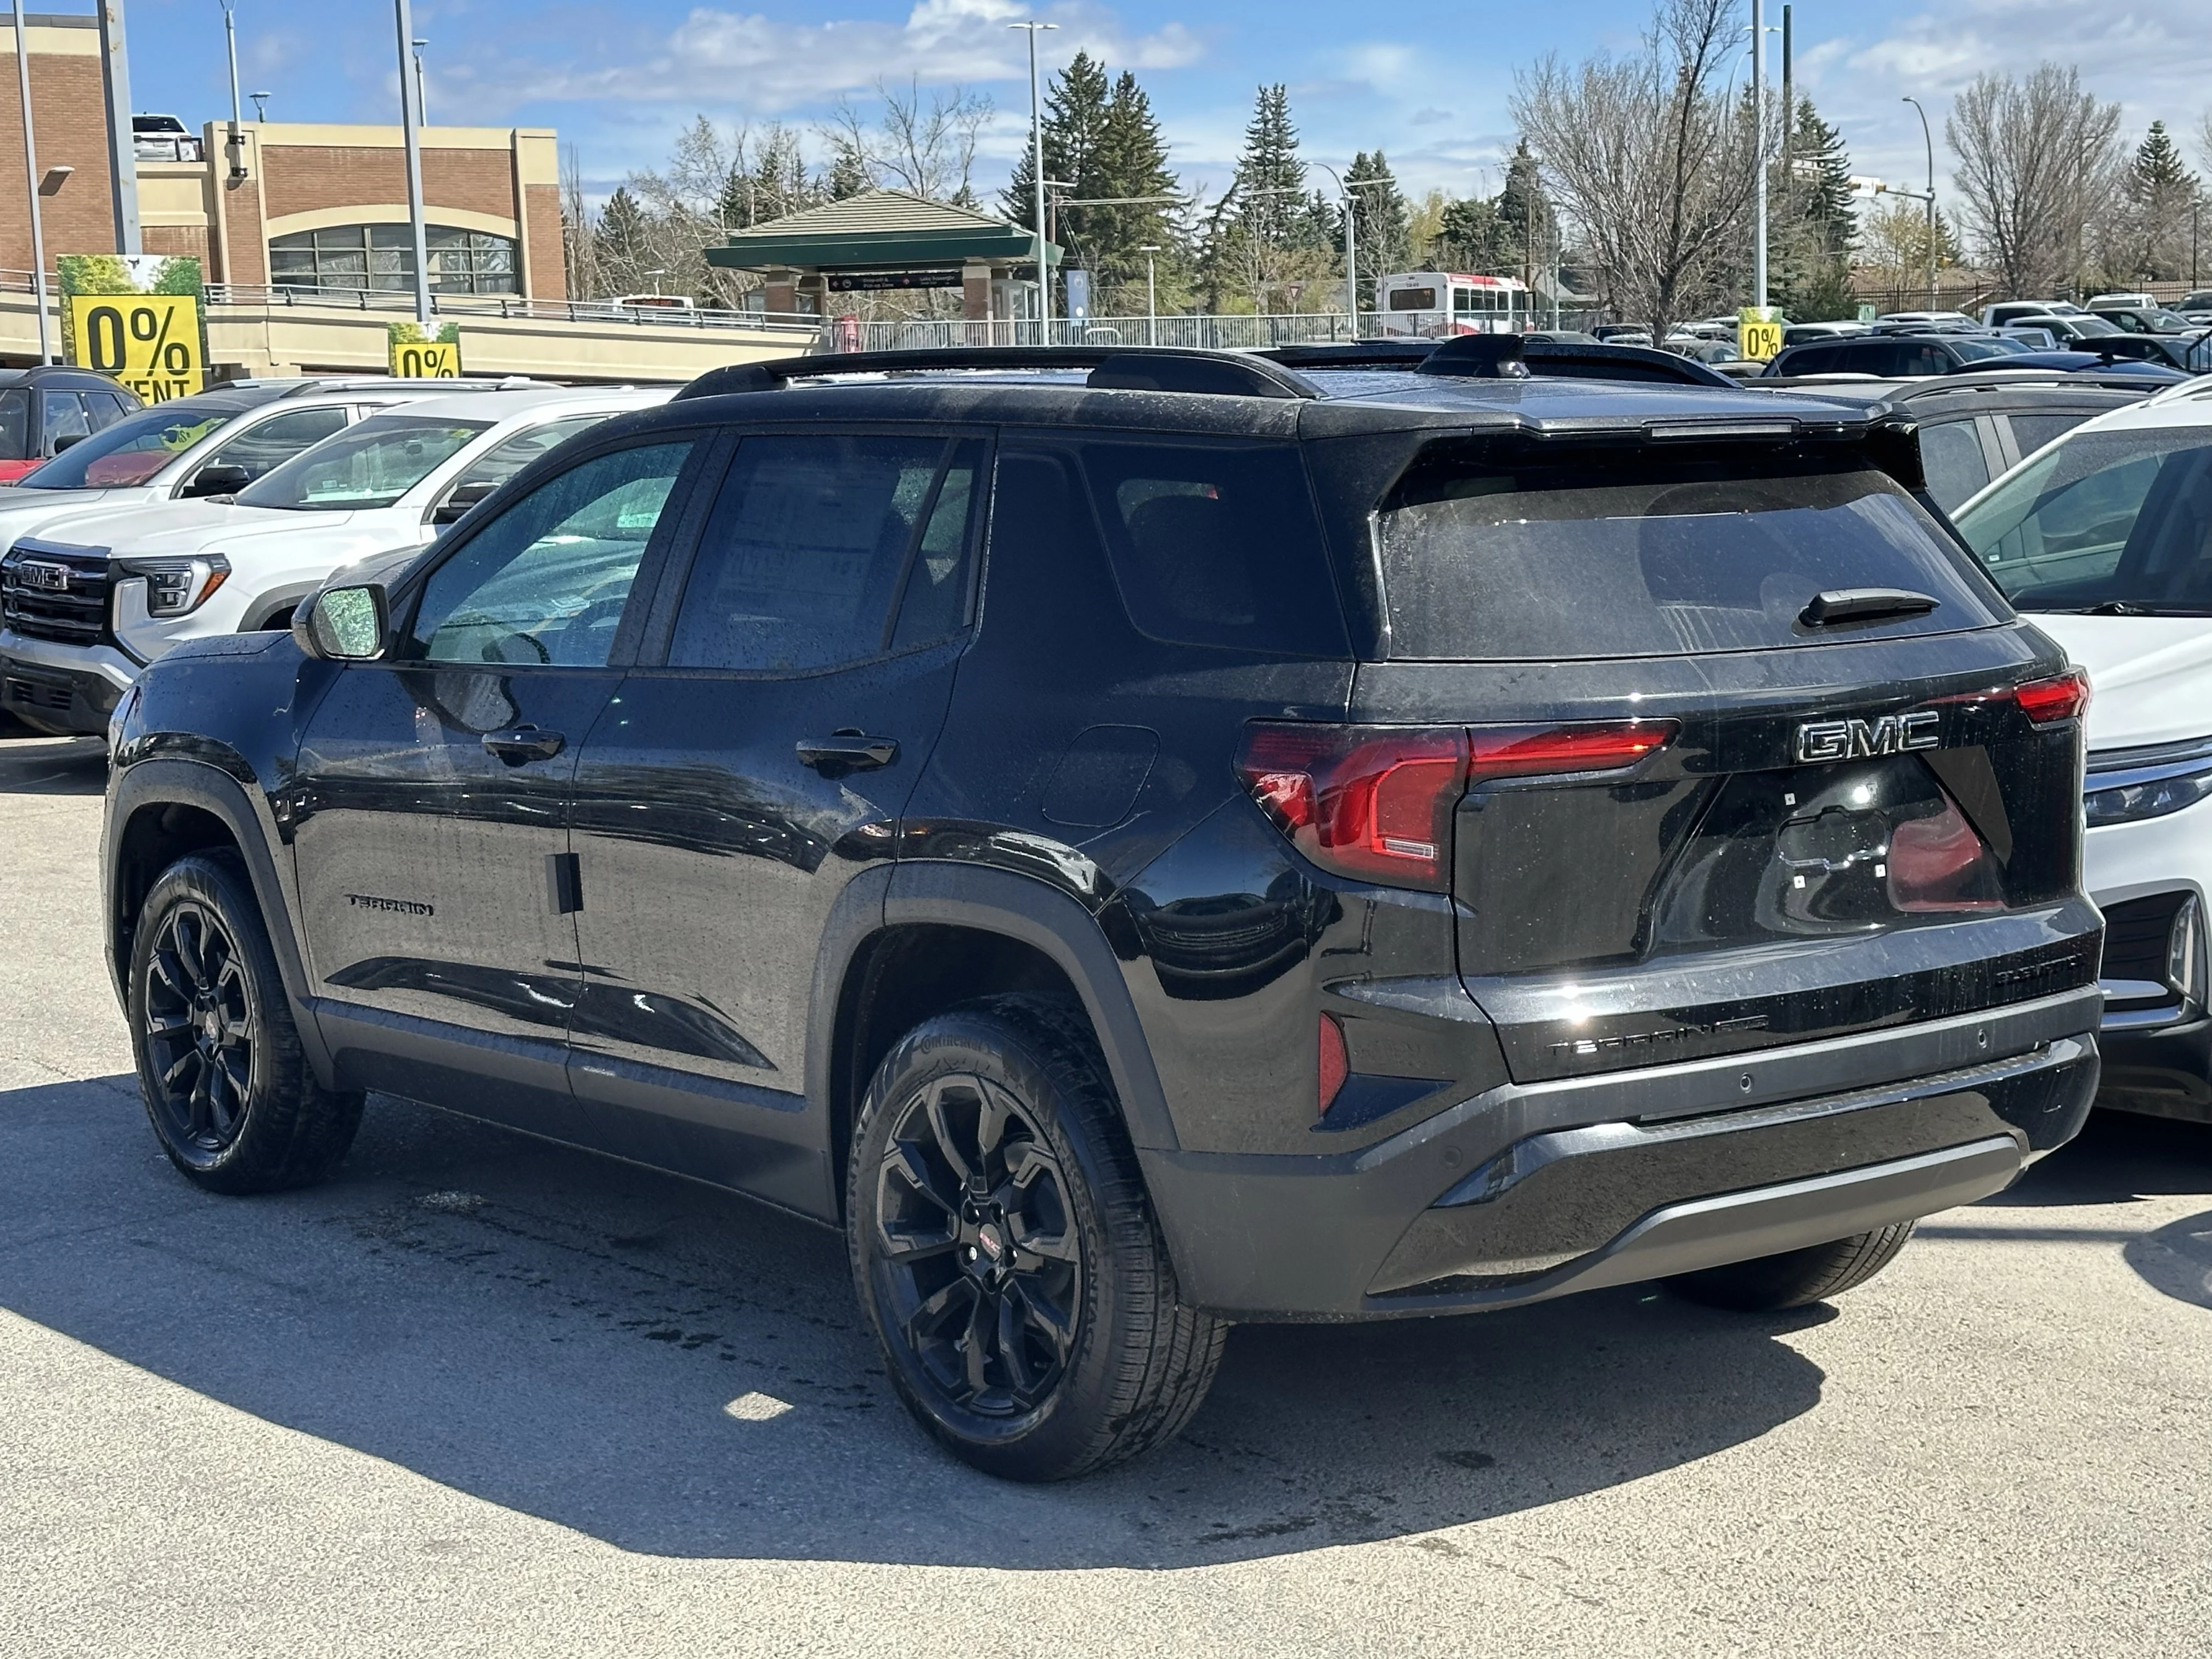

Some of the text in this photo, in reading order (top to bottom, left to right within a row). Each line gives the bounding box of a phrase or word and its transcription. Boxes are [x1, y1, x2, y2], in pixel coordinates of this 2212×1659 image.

[87, 306, 190, 377] 0%
[1748, 327, 1778, 357] 0%
[403, 348, 454, 378] 0%
[125, 380, 190, 404] ENT
[21, 564, 59, 586] GMC
[1792, 710, 1940, 763] GMC
